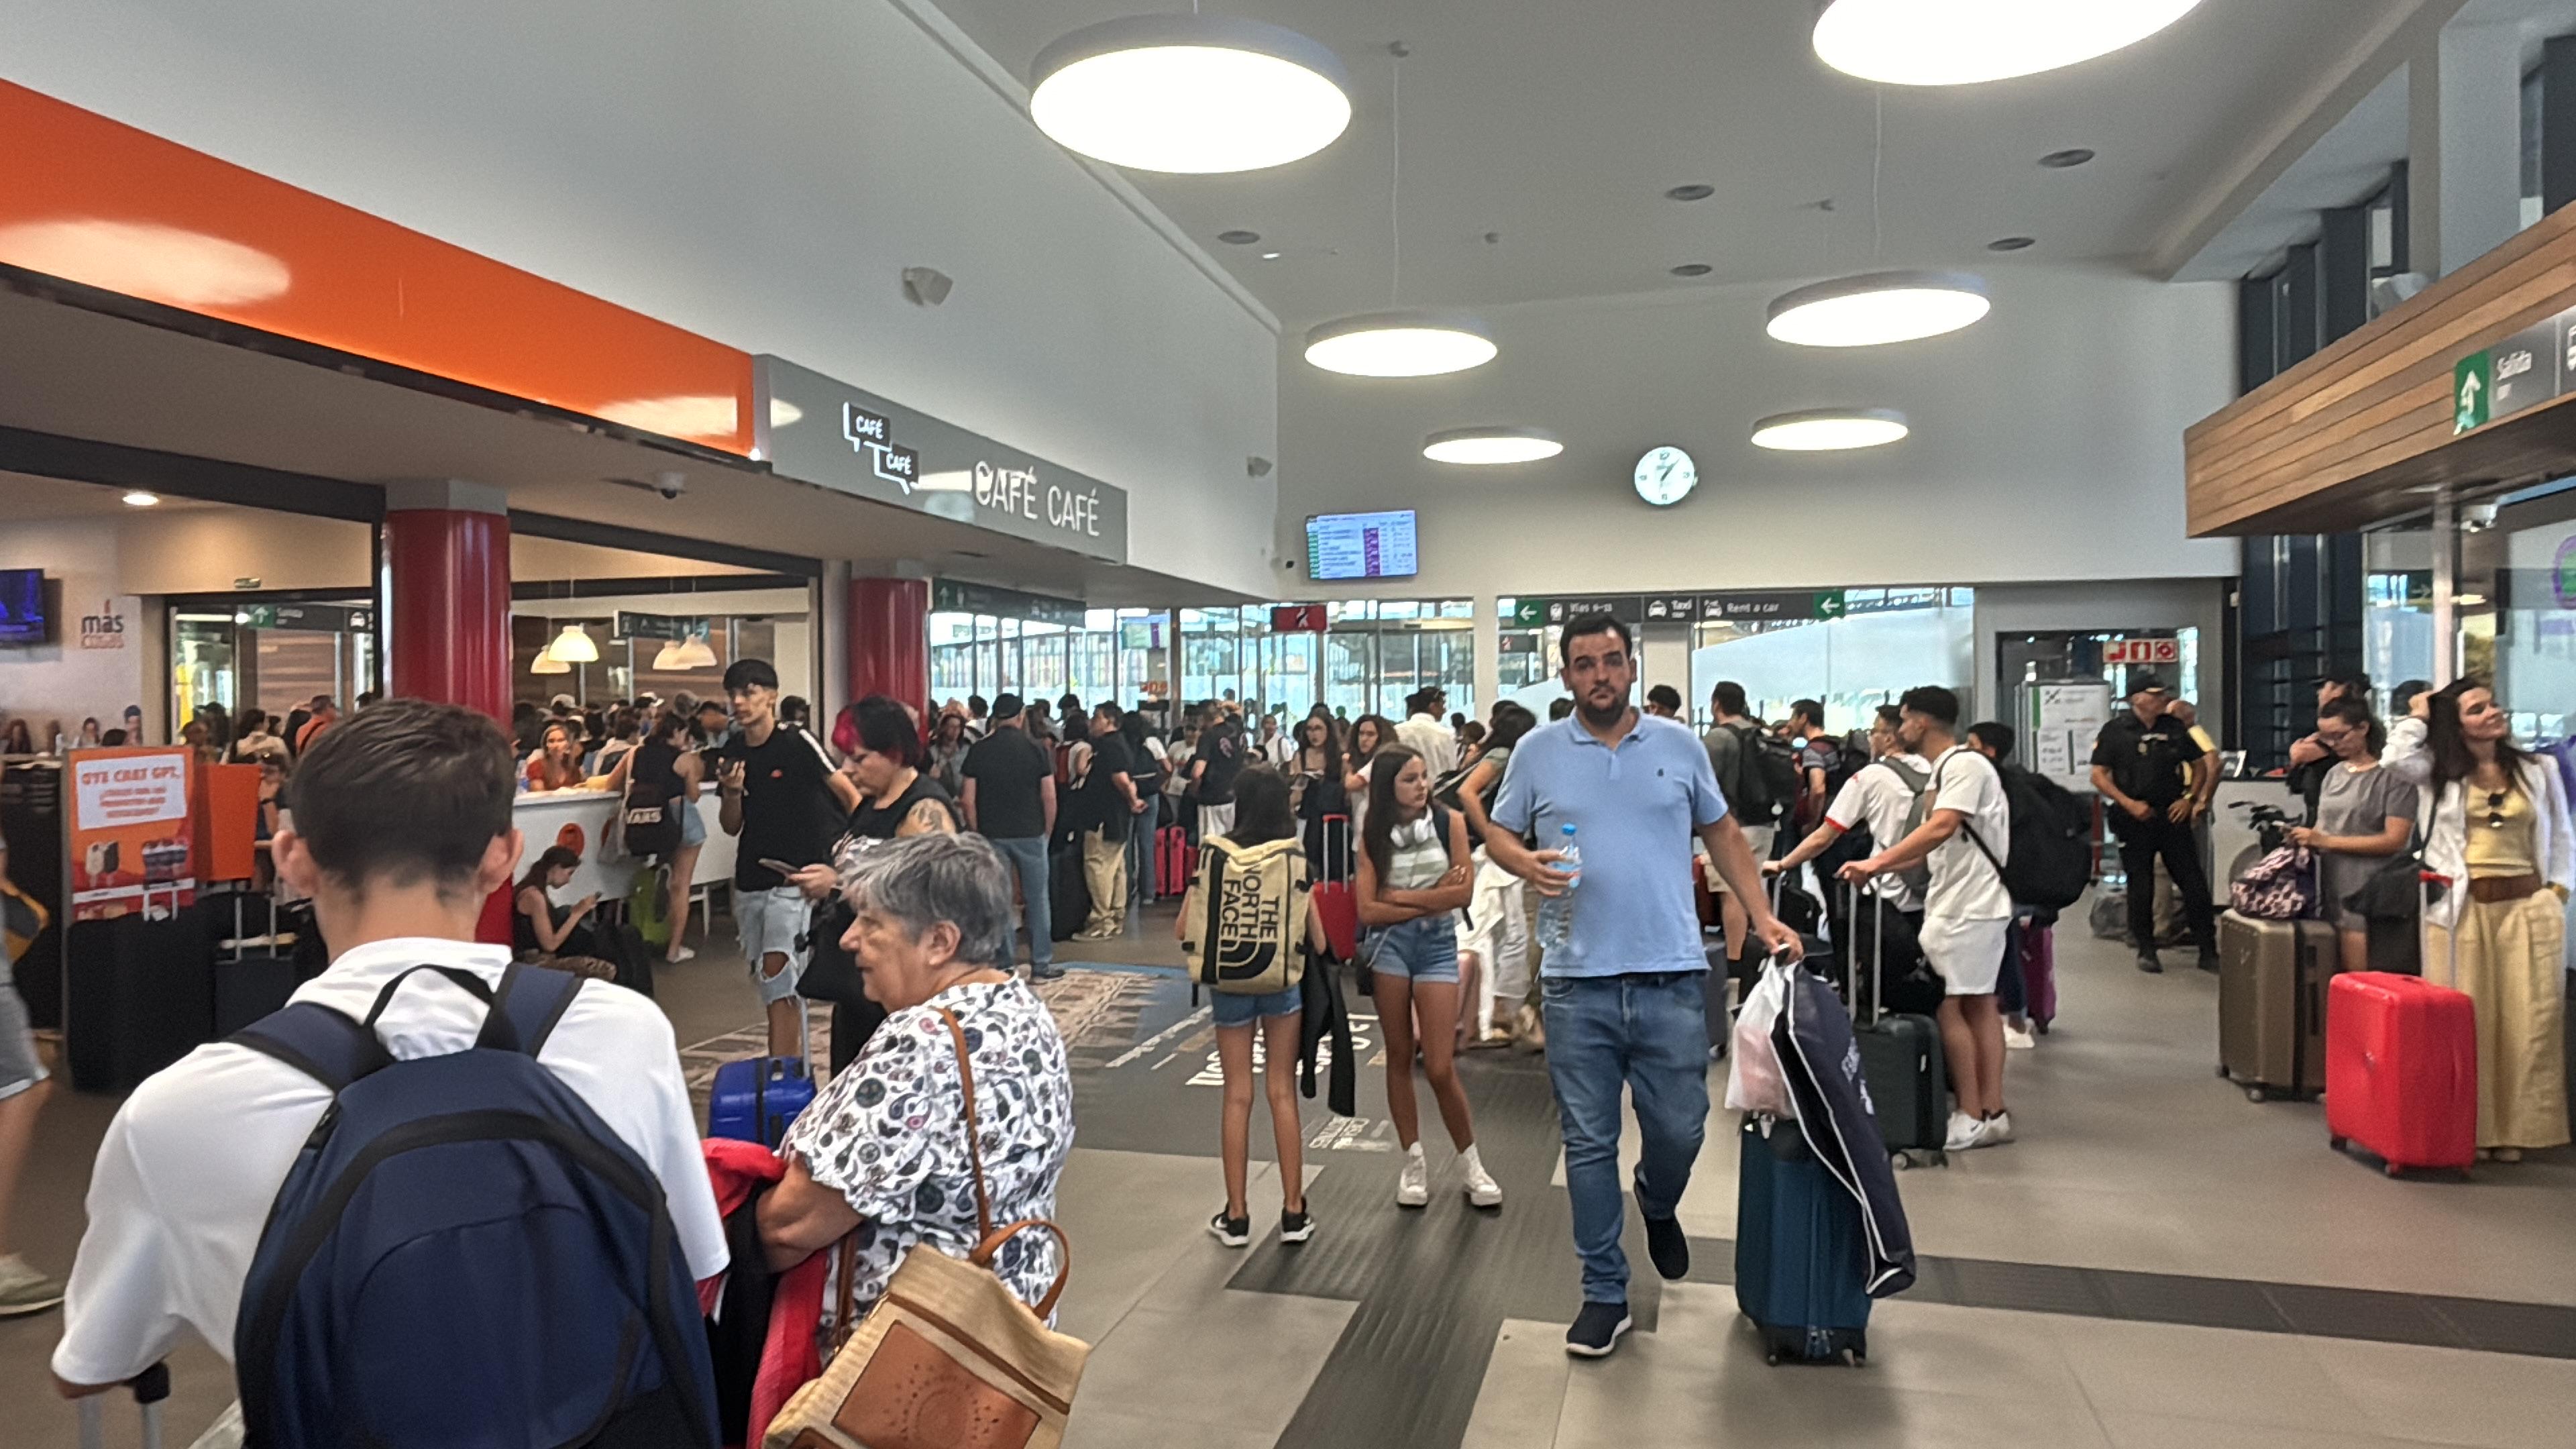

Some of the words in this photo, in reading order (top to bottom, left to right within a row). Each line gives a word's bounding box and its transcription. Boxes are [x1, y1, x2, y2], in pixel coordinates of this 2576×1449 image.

[2496, 350, 2532, 380] Salida
[856, 415, 883, 439] CAFÉ
[886, 453, 912, 475] CAFÉ
[975, 461, 1038, 519] CAFÉ
[1048, 486, 1099, 537] CAFÉ
[81, 599, 124, 633] más
[1671, 599, 1693, 610] Taxi
[1727, 603, 1751, 613] Rent
[1753, 604, 1761, 612] a
[1762, 604, 1780, 613] car
[1221, 879, 1242, 938] FACE
[1260, 896, 1280, 938] THE
